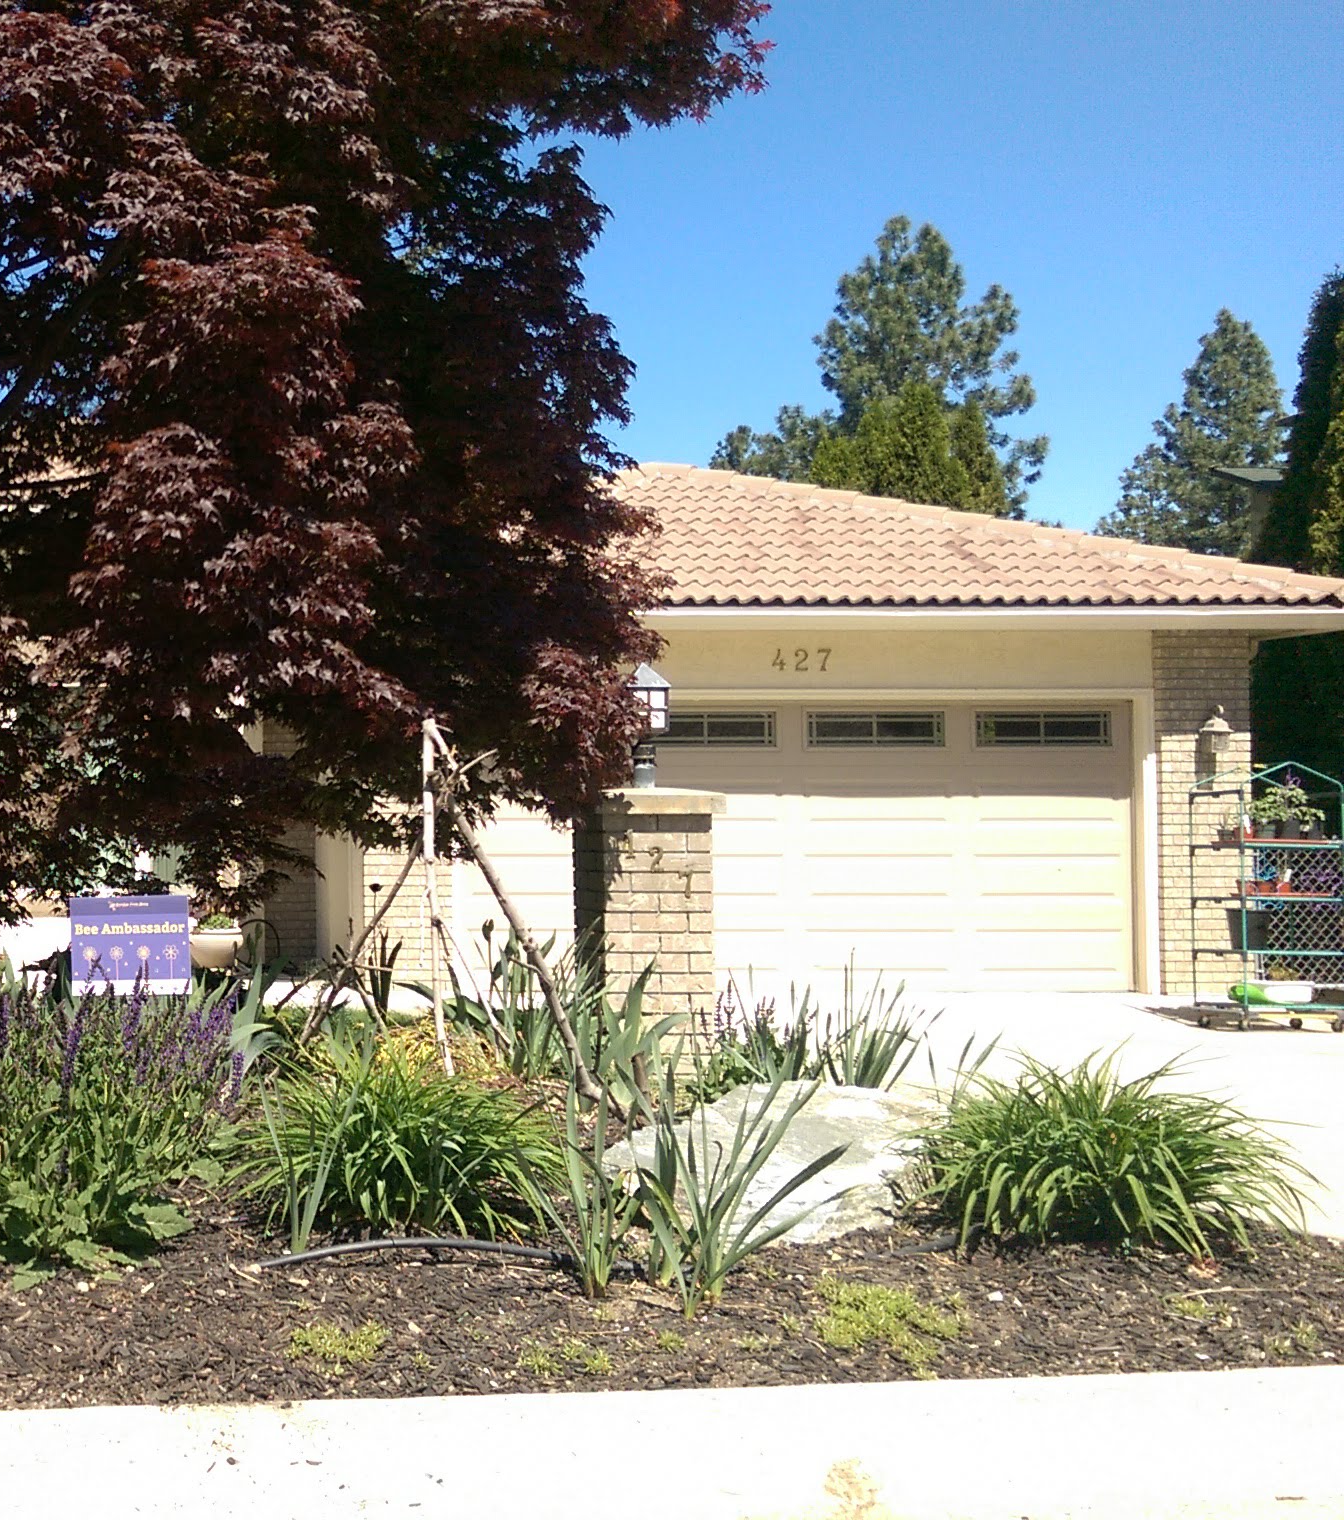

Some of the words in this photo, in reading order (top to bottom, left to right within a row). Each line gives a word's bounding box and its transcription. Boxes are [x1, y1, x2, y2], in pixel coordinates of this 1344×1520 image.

[772, 648, 832, 671] 427
[74, 923, 98, 935] Bee
[101, 921, 185, 935] Ambassador
